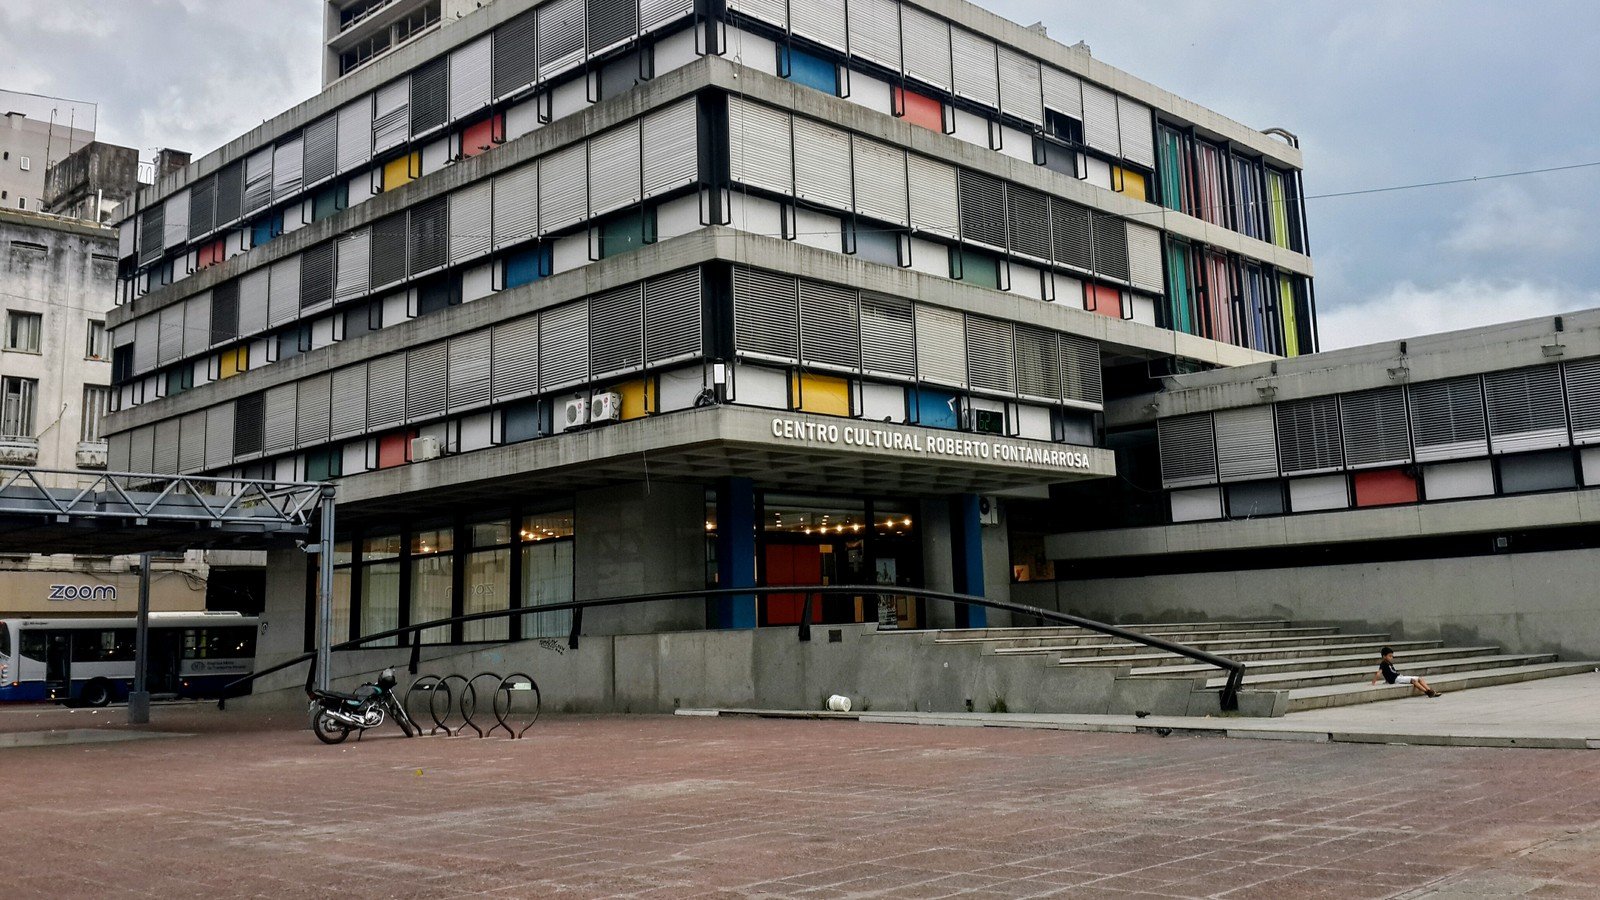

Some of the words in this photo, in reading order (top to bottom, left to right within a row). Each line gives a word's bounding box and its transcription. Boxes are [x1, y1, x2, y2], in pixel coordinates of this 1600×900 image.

[771, 418, 838, 443] CENTRO
[843, 427, 922, 451] CULTURAL
[926, 436, 989, 459] ROBERTO
[993, 443, 1090, 469] FONTANARROSA
